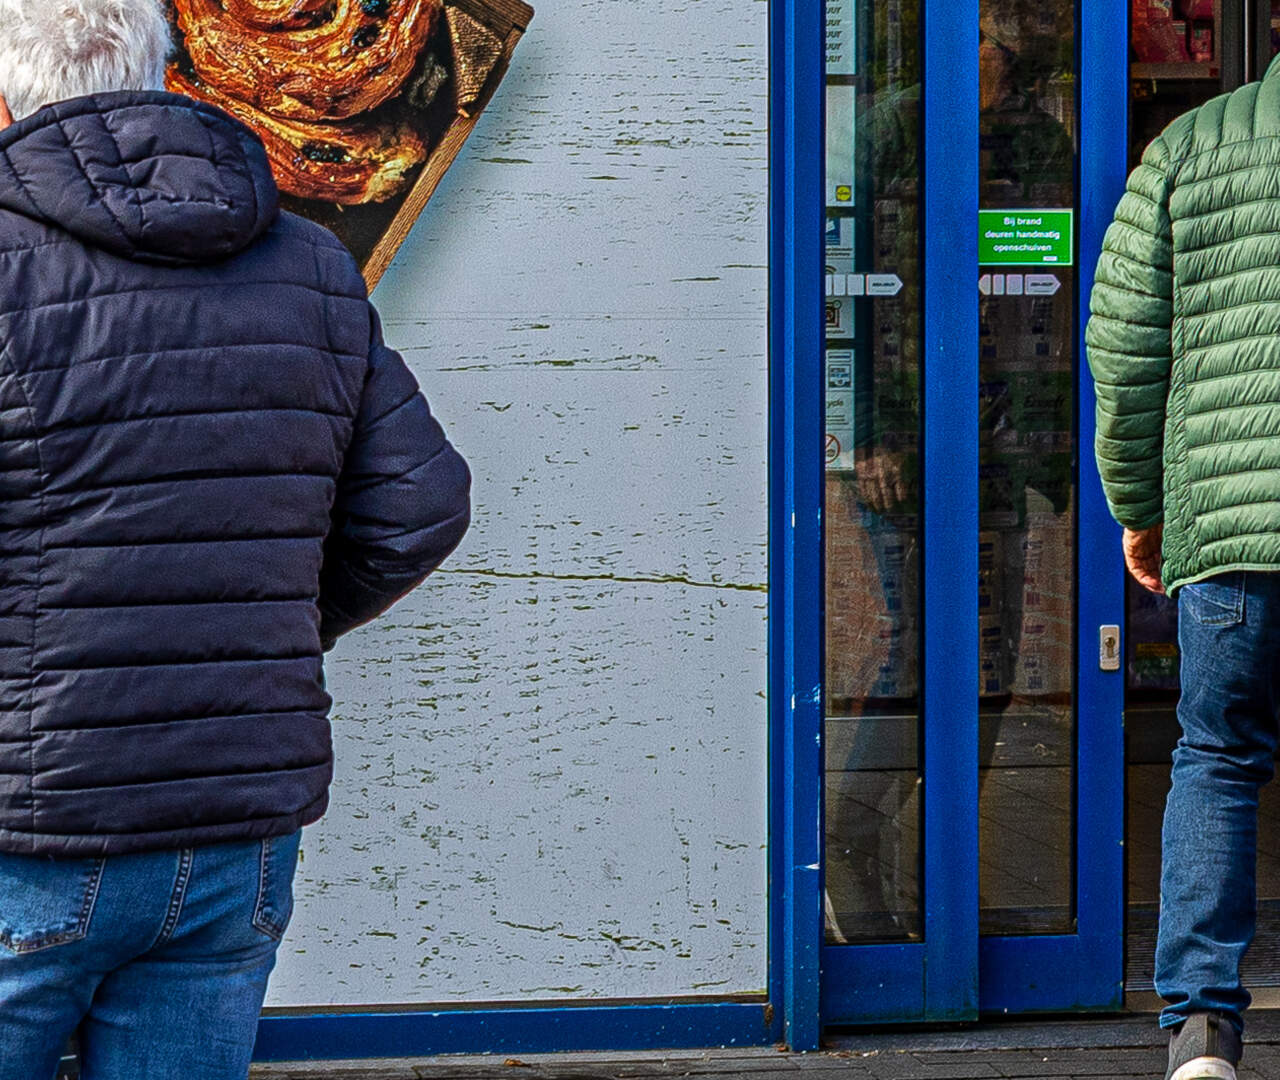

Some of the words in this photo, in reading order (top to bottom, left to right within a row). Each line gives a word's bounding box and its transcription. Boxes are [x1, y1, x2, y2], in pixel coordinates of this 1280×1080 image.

[1003, 217, 1016, 227] Bij
[1017, 217, 1042, 226] brand
[985, 231, 1015, 239] deuren
[1016, 231, 1061, 240] handmatig
[993, 245, 1053, 253] openschuiven
